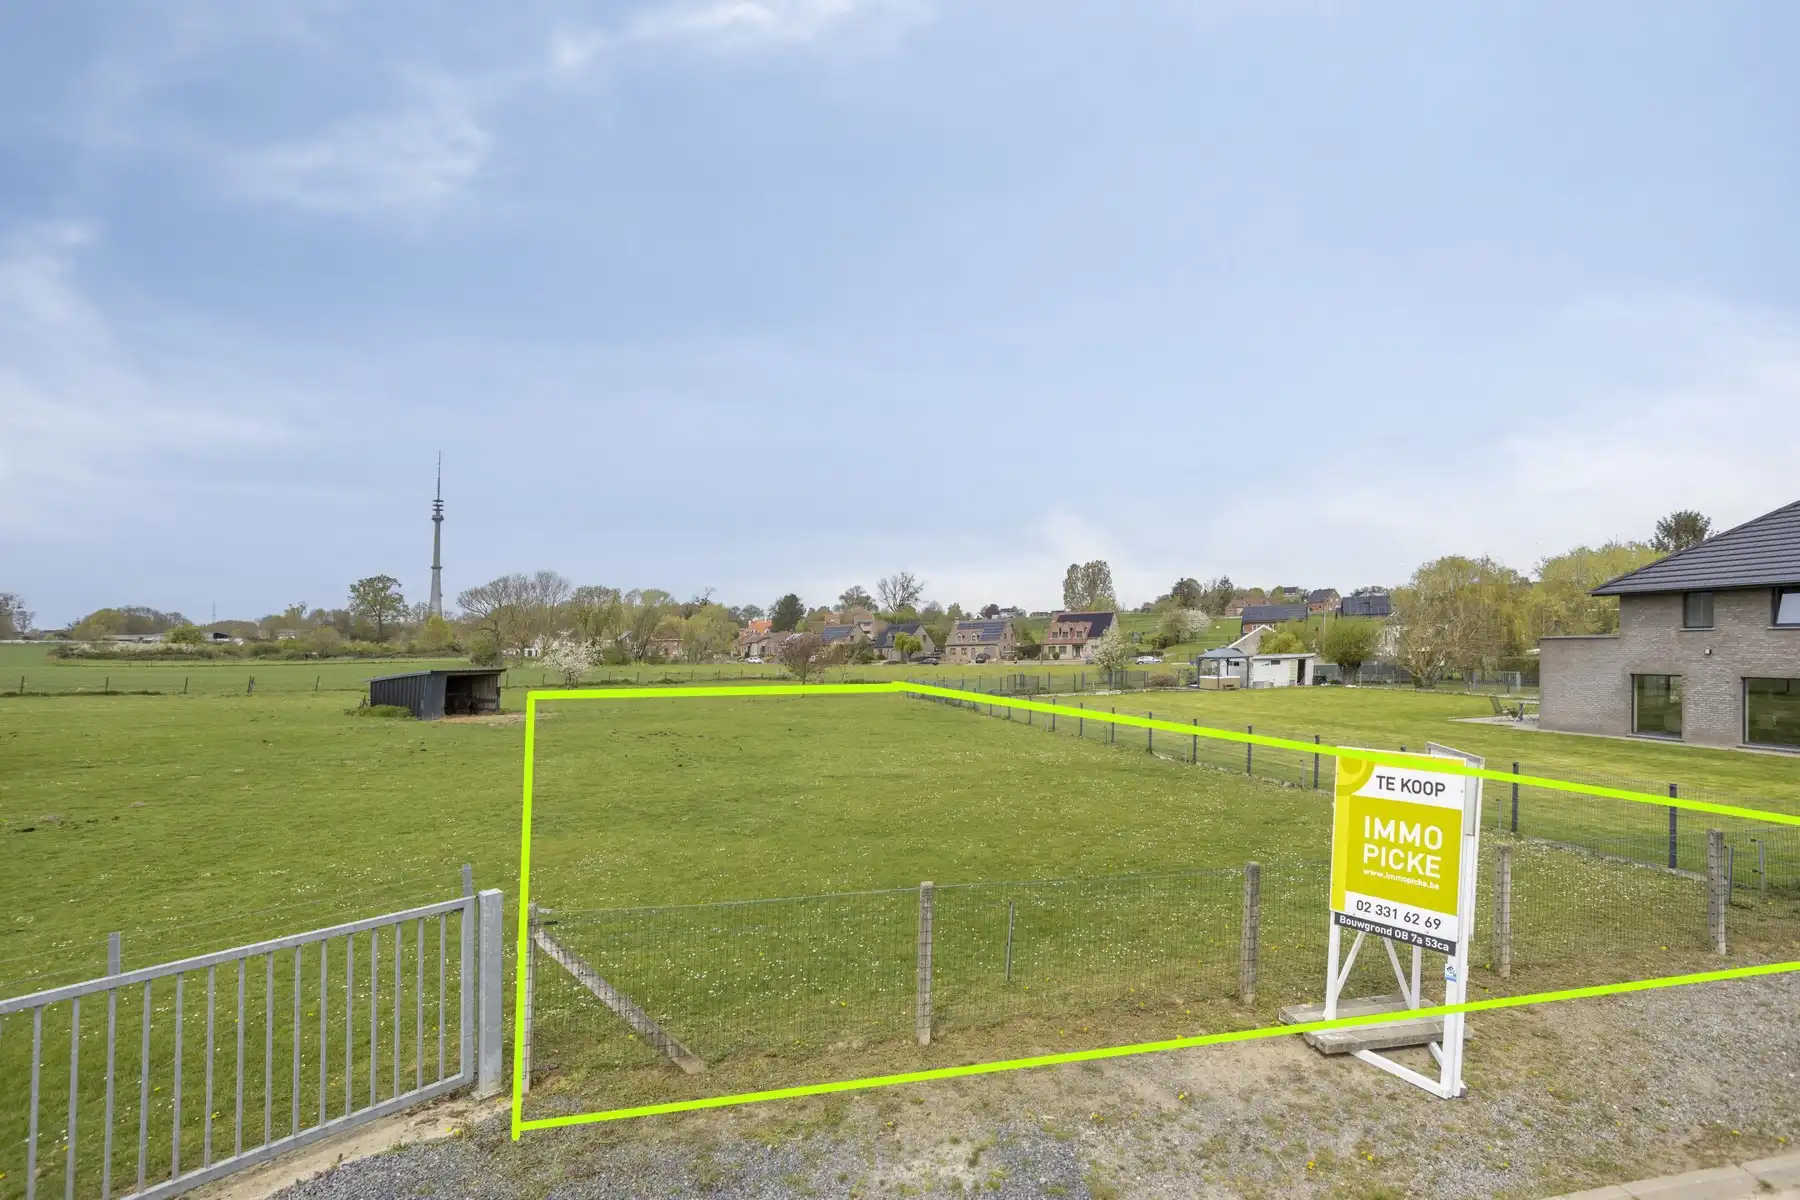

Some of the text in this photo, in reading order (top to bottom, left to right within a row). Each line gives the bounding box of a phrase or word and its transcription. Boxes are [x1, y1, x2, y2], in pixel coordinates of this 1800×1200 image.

[1376, 775, 1446, 797] TE KOOP
[1364, 816, 1443, 850] IMMO
[1363, 843, 1441, 879] PICKE
[1363, 868, 1439, 890] www.immopicke.be
[1356, 900, 1441, 930] 02 331 62 69
[1339, 915, 1392, 936] Bouwgrond
[1411, 934, 1423, 944] 7a
[1425, 938, 1449, 951] 53ca
